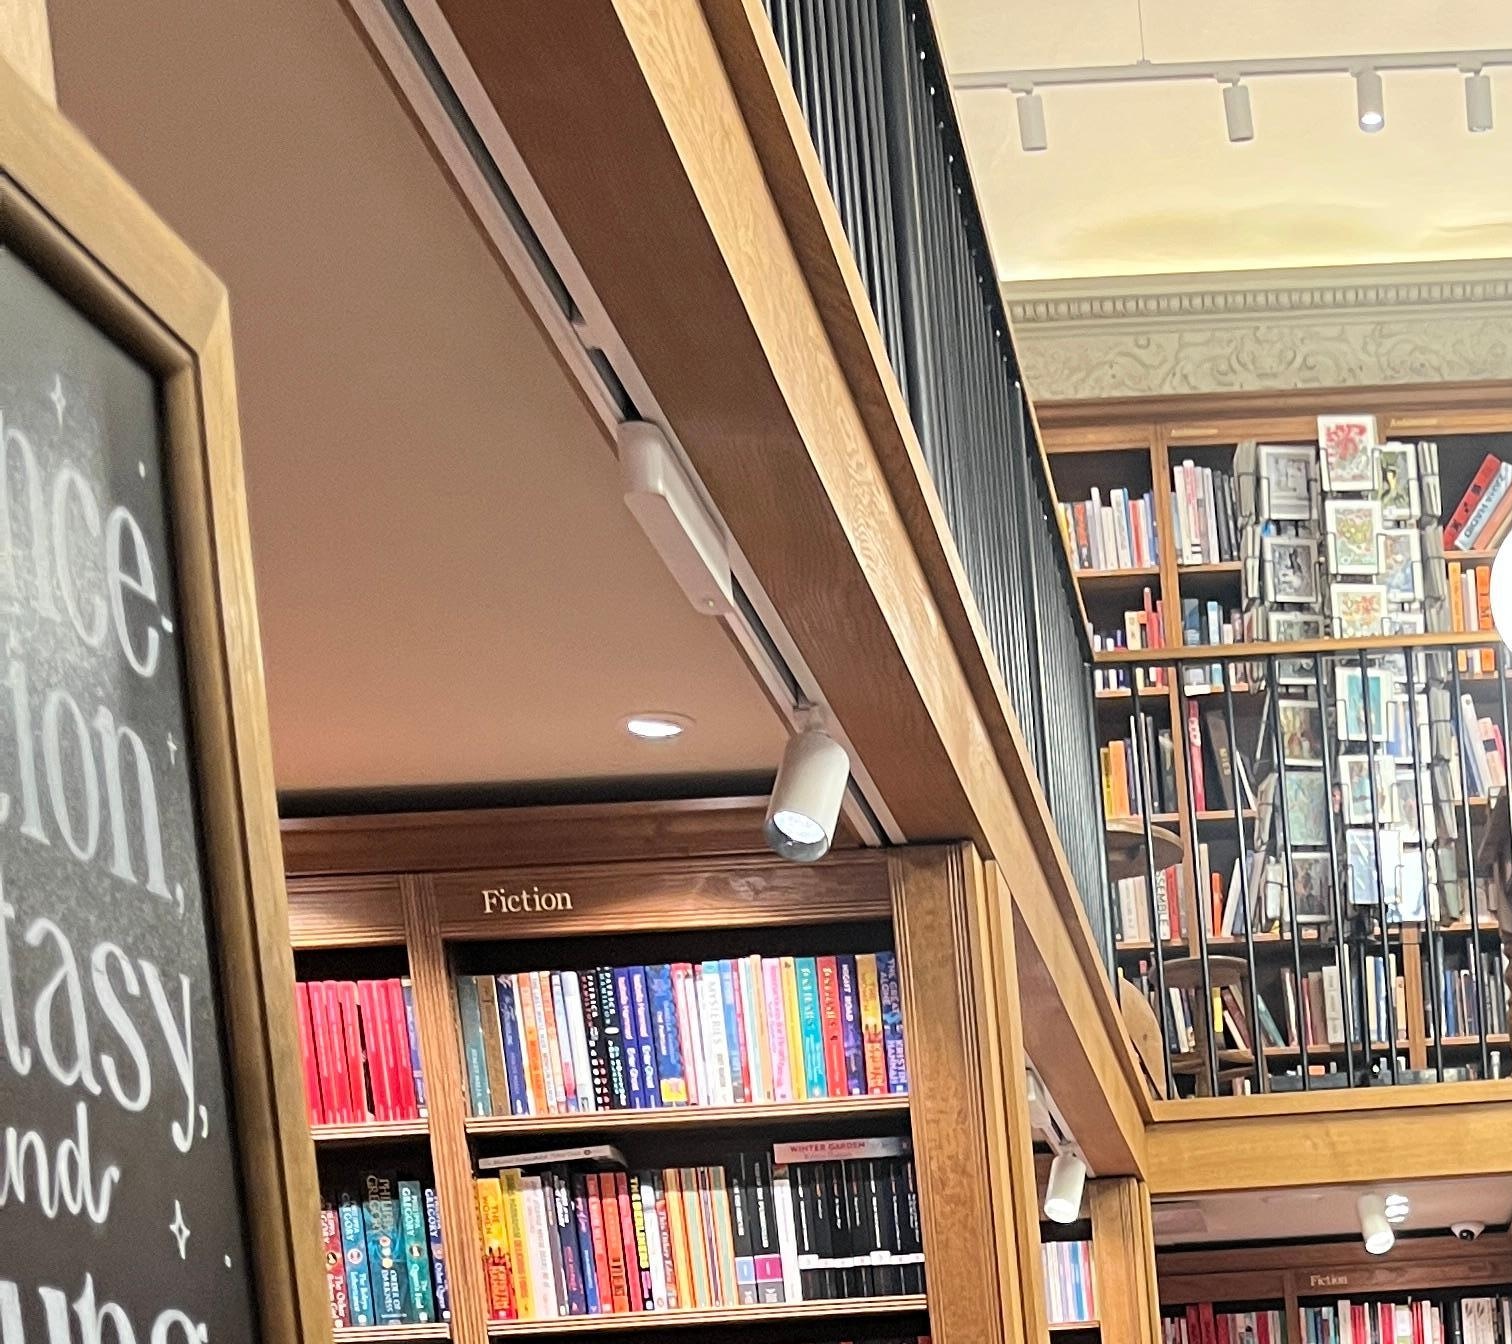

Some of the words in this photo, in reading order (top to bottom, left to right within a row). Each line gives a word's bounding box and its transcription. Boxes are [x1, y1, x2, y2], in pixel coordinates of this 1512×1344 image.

[481, 887, 574, 914] Fiction
[843, 995, 854, 1022] ROAD
[788, 1142, 827, 1153] WINTER
[827, 1140, 866, 1151] GARDEN
[366, 1175, 382, 1233] GREGORY
[402, 1187, 416, 1236] GREGORY
[425, 1189, 438, 1237] GREGORY
[482, 1196, 491, 1235] WOMEN
[381, 1269, 394, 1312] DARKNESS
[390, 1270, 399, 1297] ORDER
[1309, 1273, 1348, 1288] Fiction
